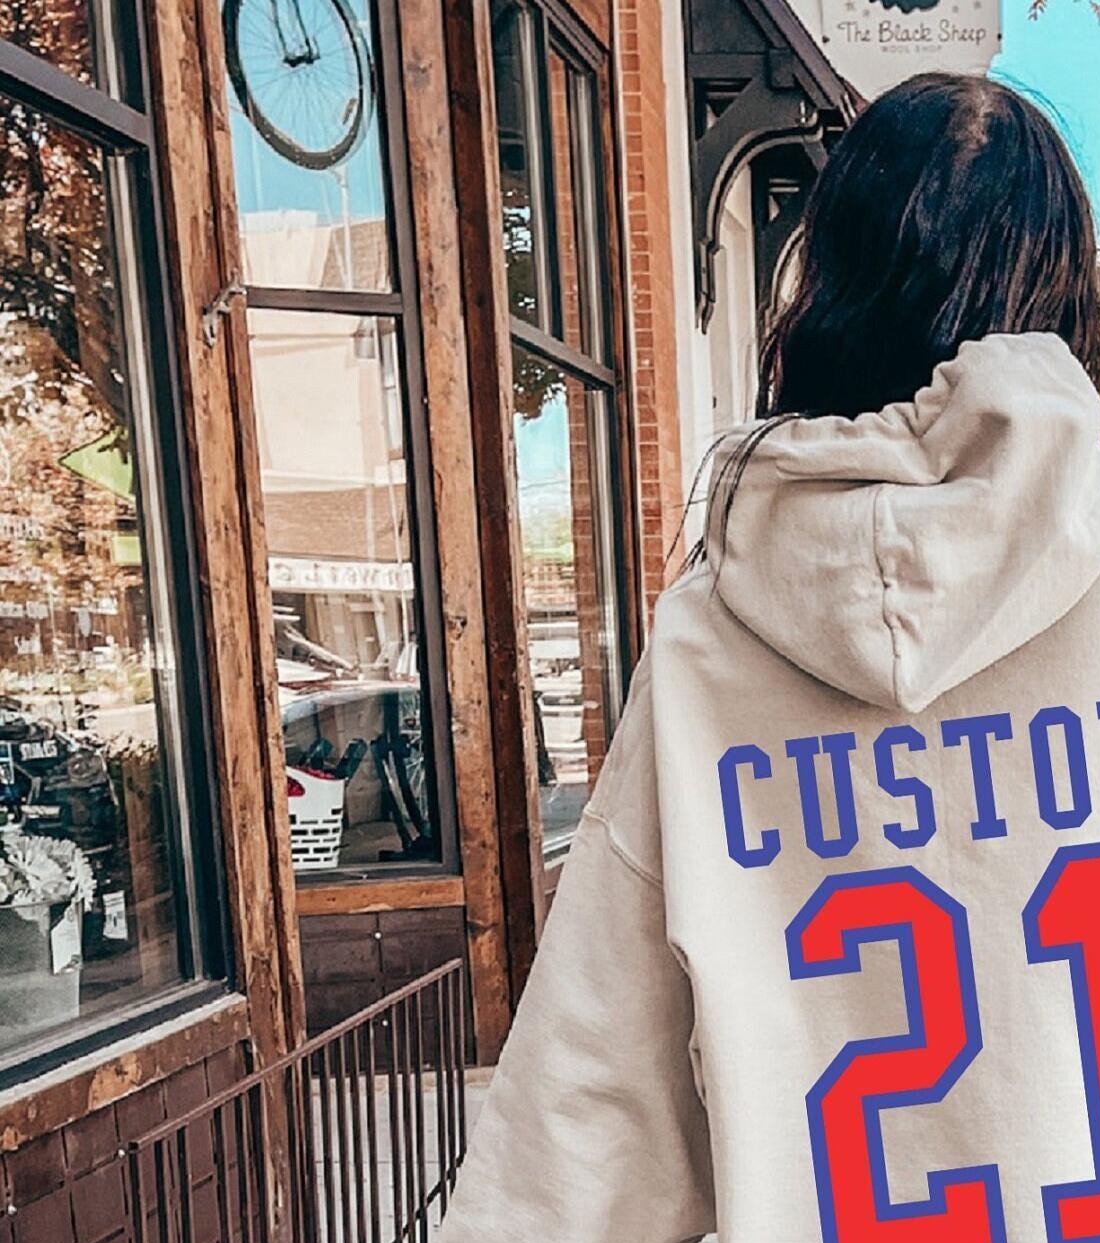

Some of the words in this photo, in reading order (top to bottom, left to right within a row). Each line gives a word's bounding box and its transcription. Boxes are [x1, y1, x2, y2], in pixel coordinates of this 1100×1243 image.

[837, 21, 871, 43] The
[878, 20, 933, 43] Black
[937, 19, 987, 45] Sheep
